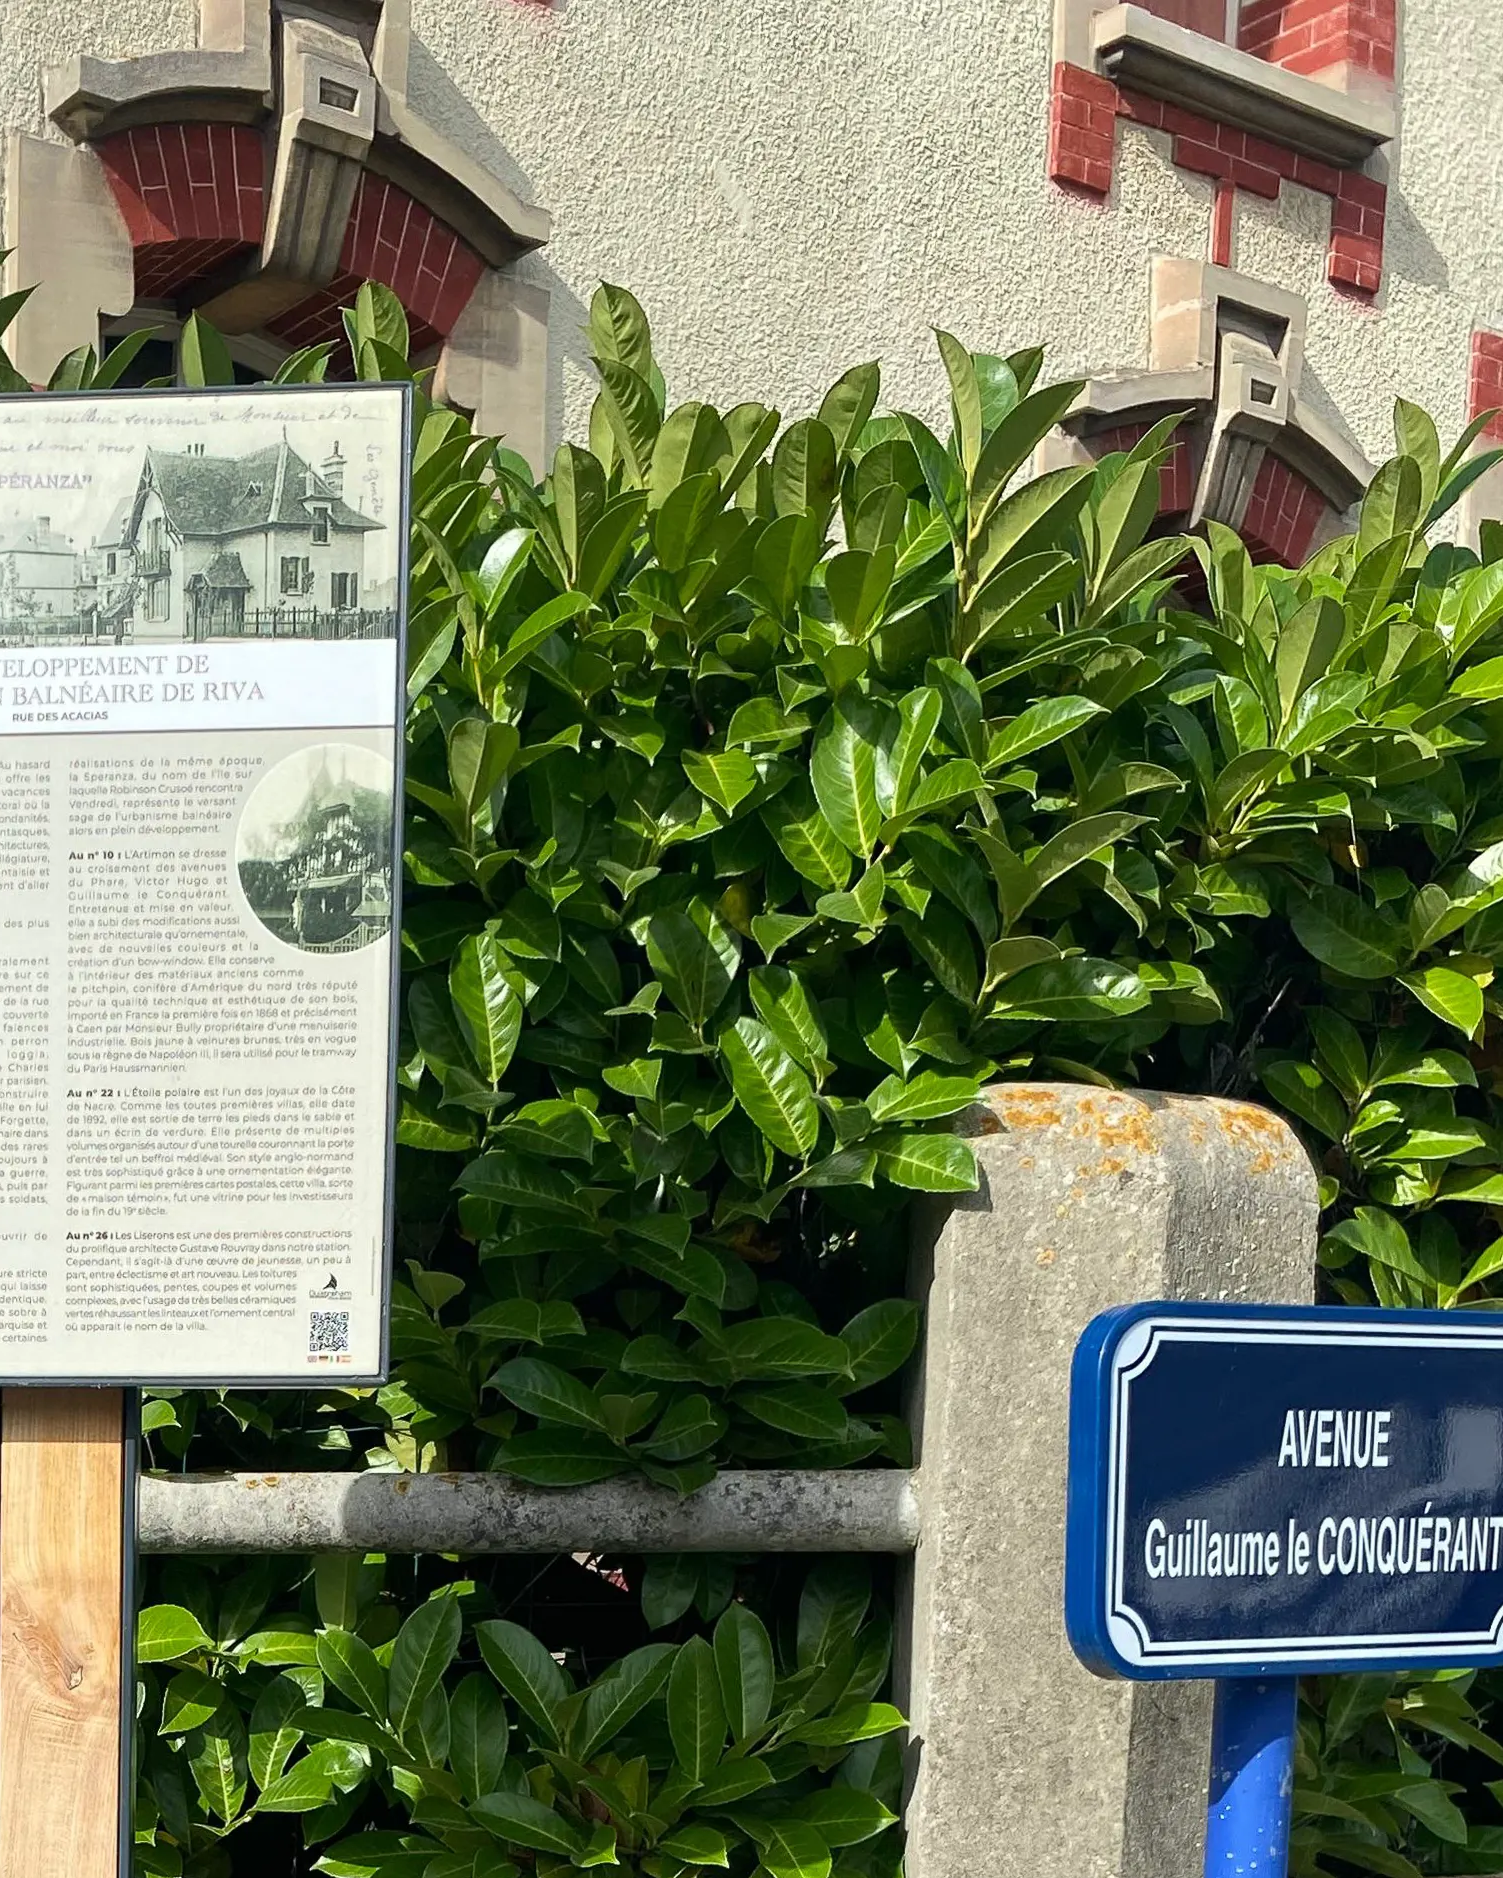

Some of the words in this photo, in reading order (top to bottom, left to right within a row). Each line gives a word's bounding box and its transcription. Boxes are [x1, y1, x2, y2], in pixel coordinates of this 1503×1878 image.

[176, 653, 210, 674] DE
[12, 680, 154, 706] BALNÉAIRE
[162, 682, 196, 702] DE
[203, 680, 265, 702] RIVA
[12, 713, 34, 722] RUE
[37, 712, 59, 721] DES
[61, 711, 108, 721] ACACIAS
[68, 849, 84, 859] Au
[86, 849, 99, 858] n°
[102, 849, 114, 858] 10
[66, 1088, 82, 1097] Au
[85, 1087, 97, 1097] n°
[100, 1087, 113, 1096] 22
[65, 1230, 81, 1239] Au
[82, 1230, 94, 1239] n°
[94, 1230, 108, 1239] 26
[1278, 1409, 1391, 1468] AVENUE
[1144, 1518, 1280, 1579] Guillaume
[1287, 1519, 1311, 1576] le
[1317, 1502, 1503, 1577] CONQUÉRANT
